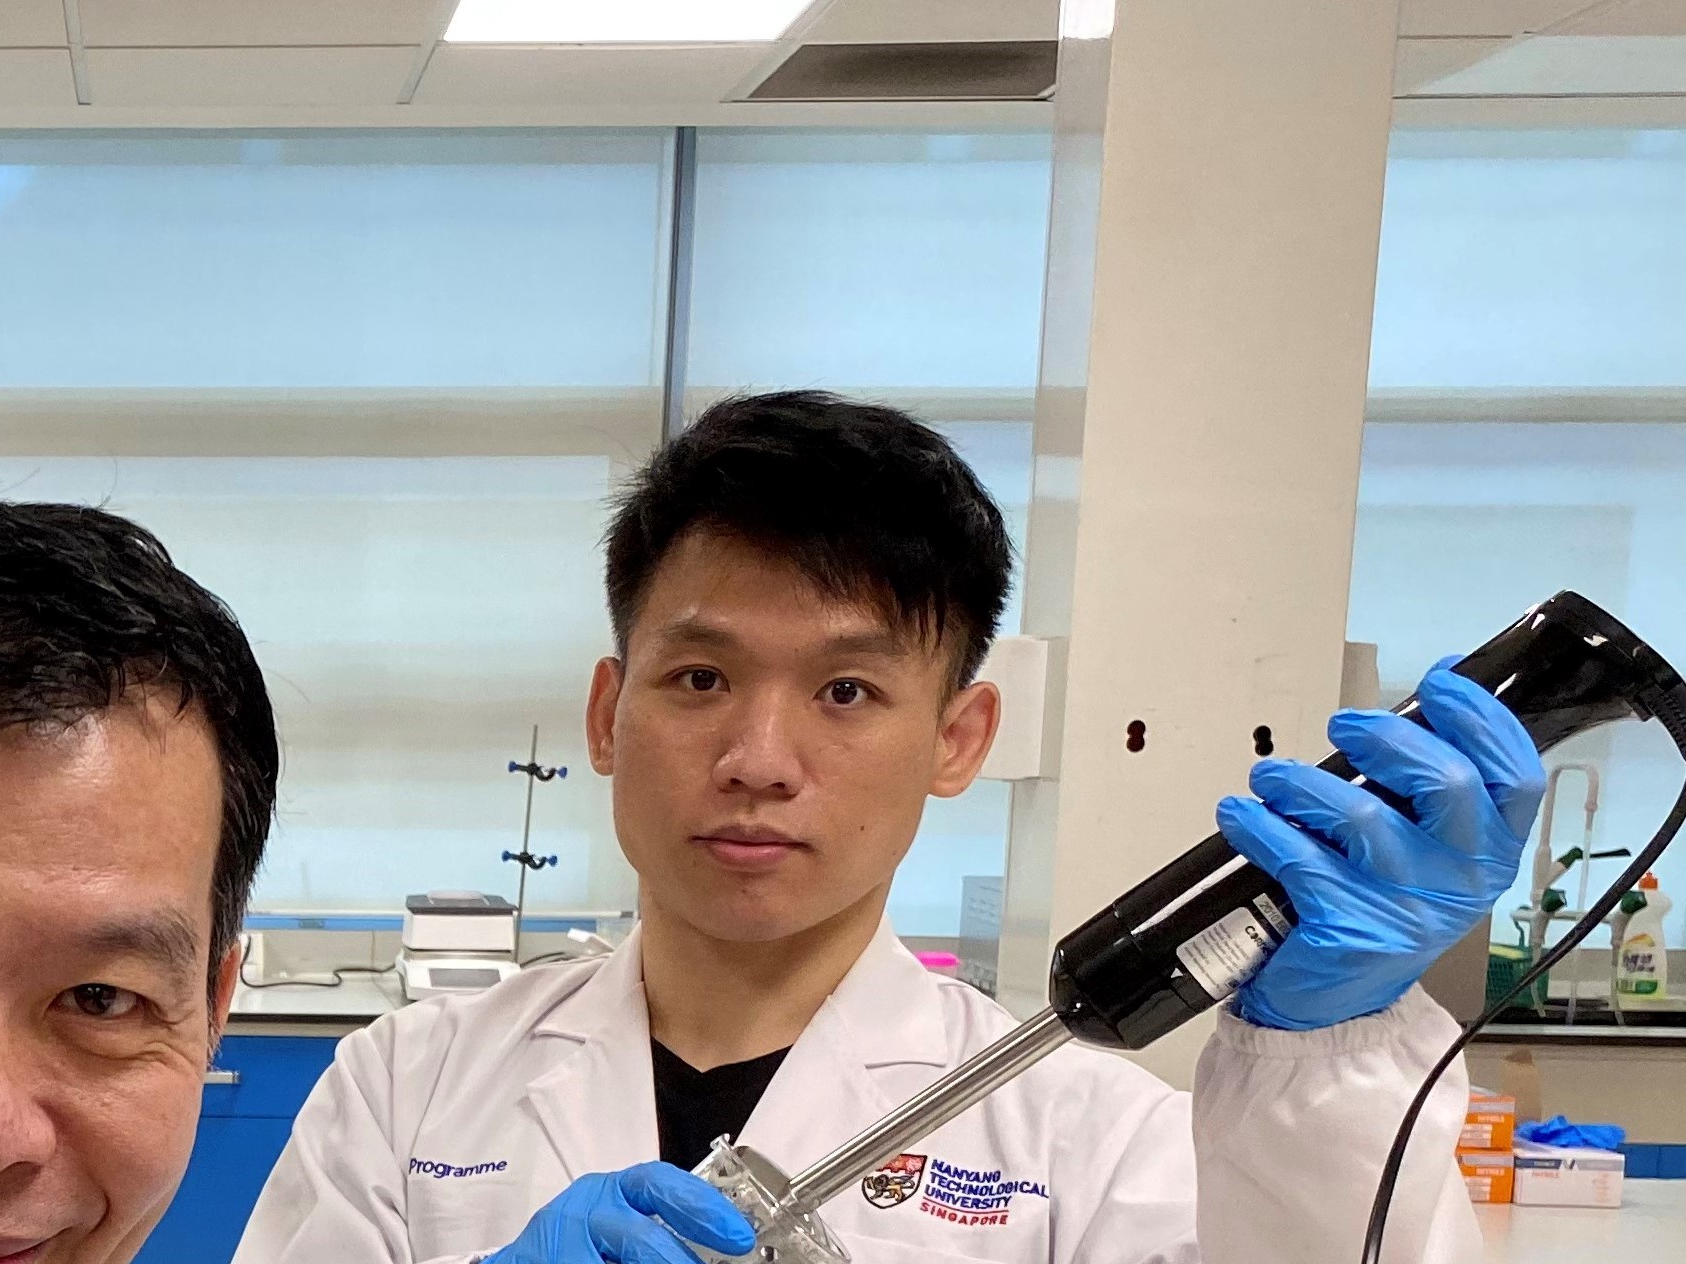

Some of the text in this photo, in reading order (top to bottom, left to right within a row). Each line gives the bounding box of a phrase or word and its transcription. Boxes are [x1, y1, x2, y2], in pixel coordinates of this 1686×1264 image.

[408, 1157, 507, 1179] Programme
[931, 1158, 1001, 1184] NANYANG
[924, 1184, 1012, 1210] UNIVERSITY
[929, 1171, 1049, 1198] TECHNOLOGICAL
[919, 1202, 1009, 1226] SINGAPORE
